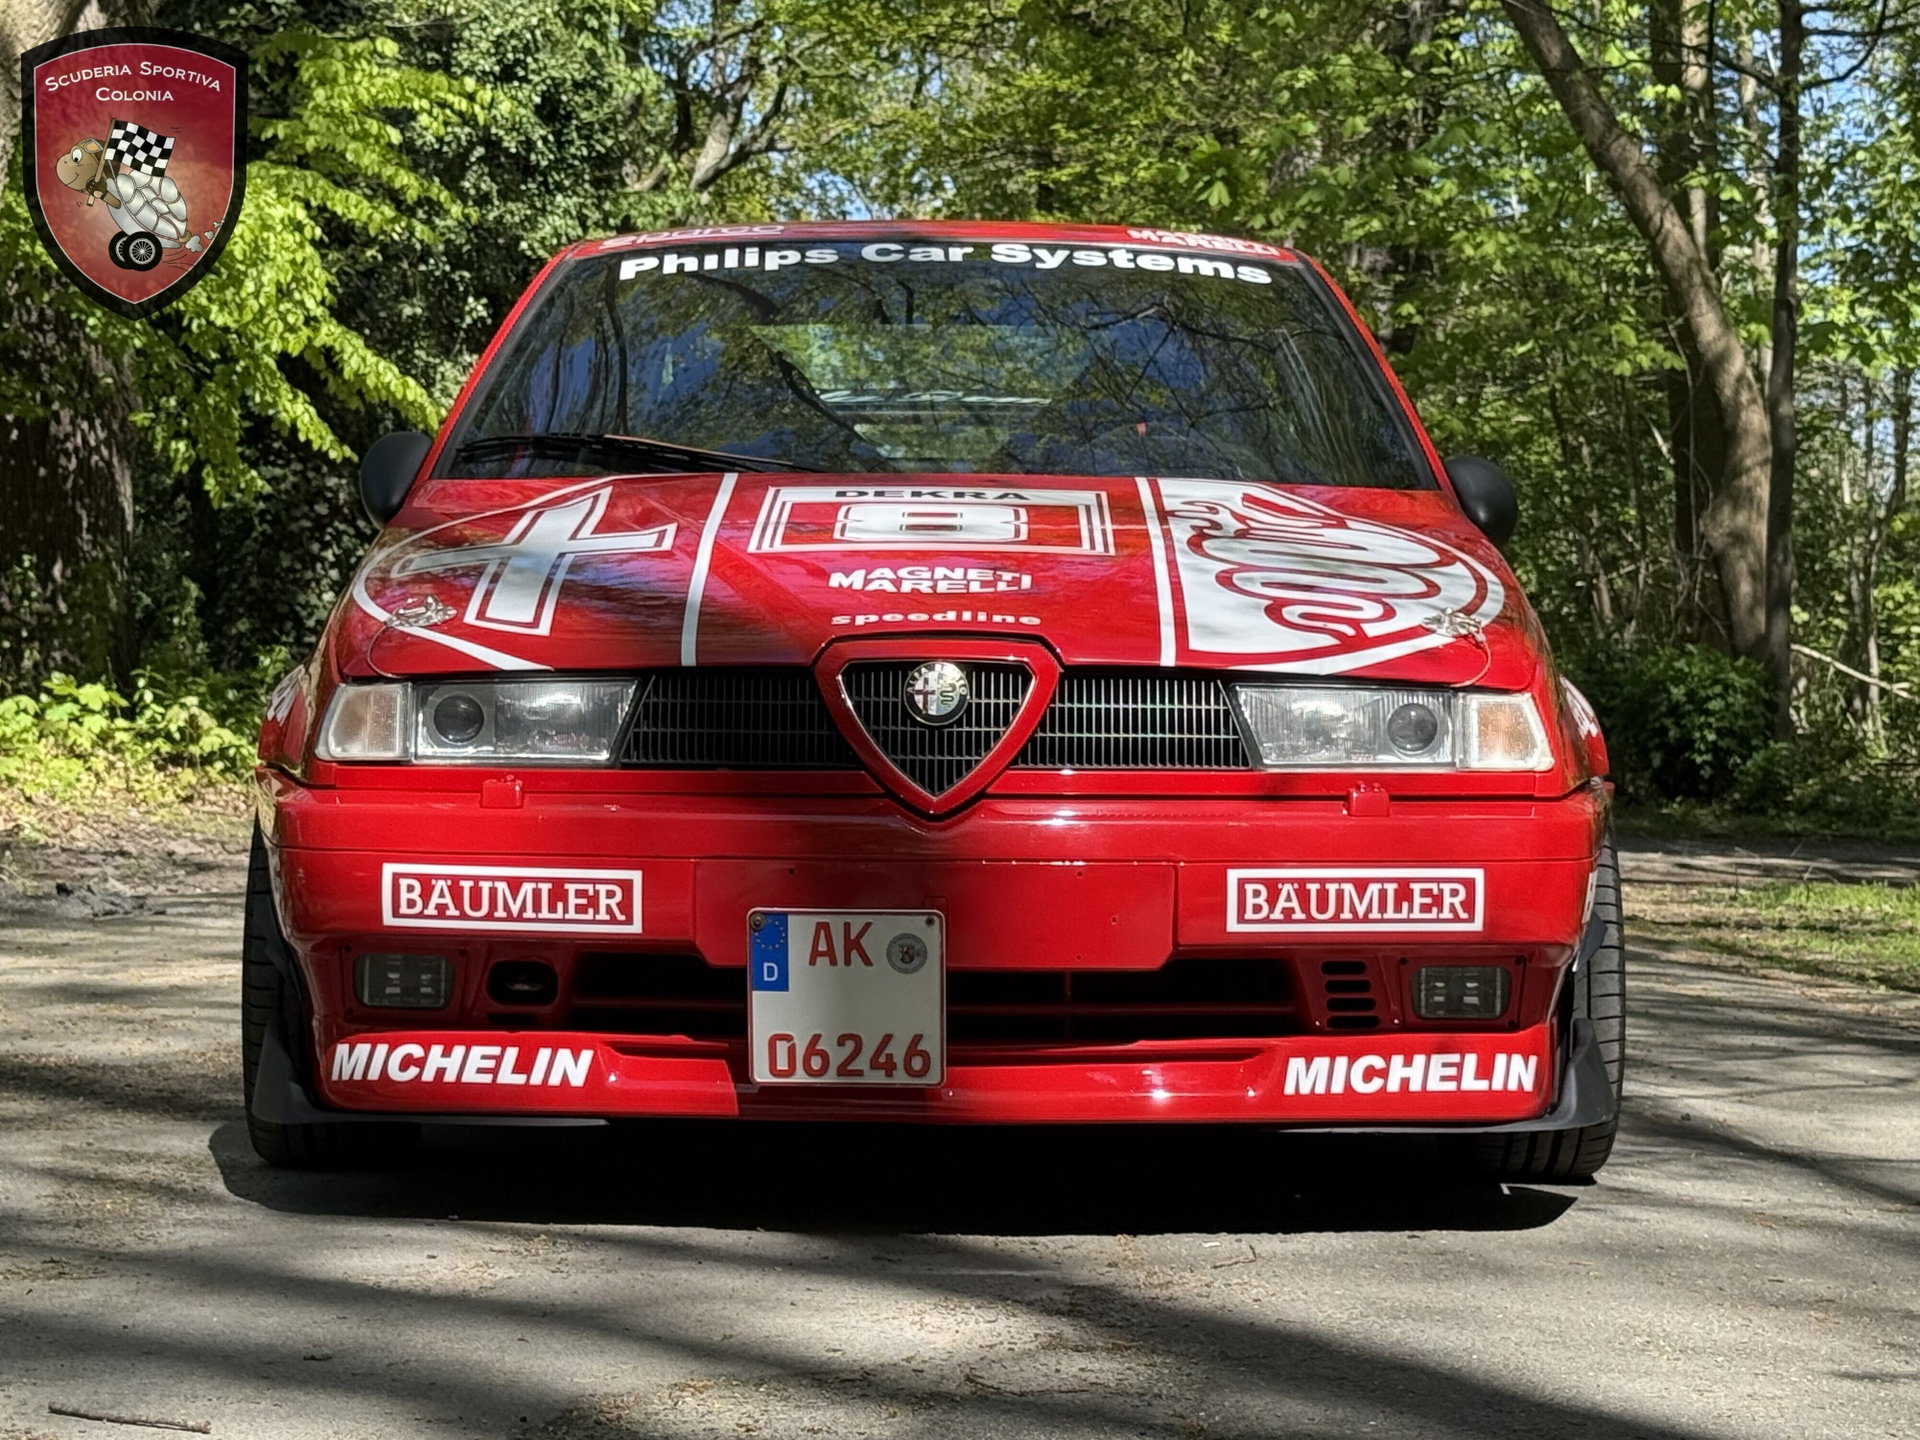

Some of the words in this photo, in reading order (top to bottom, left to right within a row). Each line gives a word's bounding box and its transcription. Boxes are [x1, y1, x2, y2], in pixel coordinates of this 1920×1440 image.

[619, 247, 839, 281] Philips
[861, 243, 974, 263] Car
[991, 244, 1272, 284] Systems
[835, 490, 1031, 501] DEKRA
[828, 566, 1032, 587] MAGNETI
[828, 572, 1032, 593] MARELLI
[831, 610, 1042, 626] speedline
[399, 878, 626, 921] BÄUMLER
[1244, 883, 1469, 920] BÄUMLER
[808, 921, 873, 967] AK
[763, 962, 779, 981] D
[331, 1043, 594, 1087] MICHELIN
[768, 1033, 931, 1078] 06246
[1284, 1053, 1537, 1095] MICHELIN
